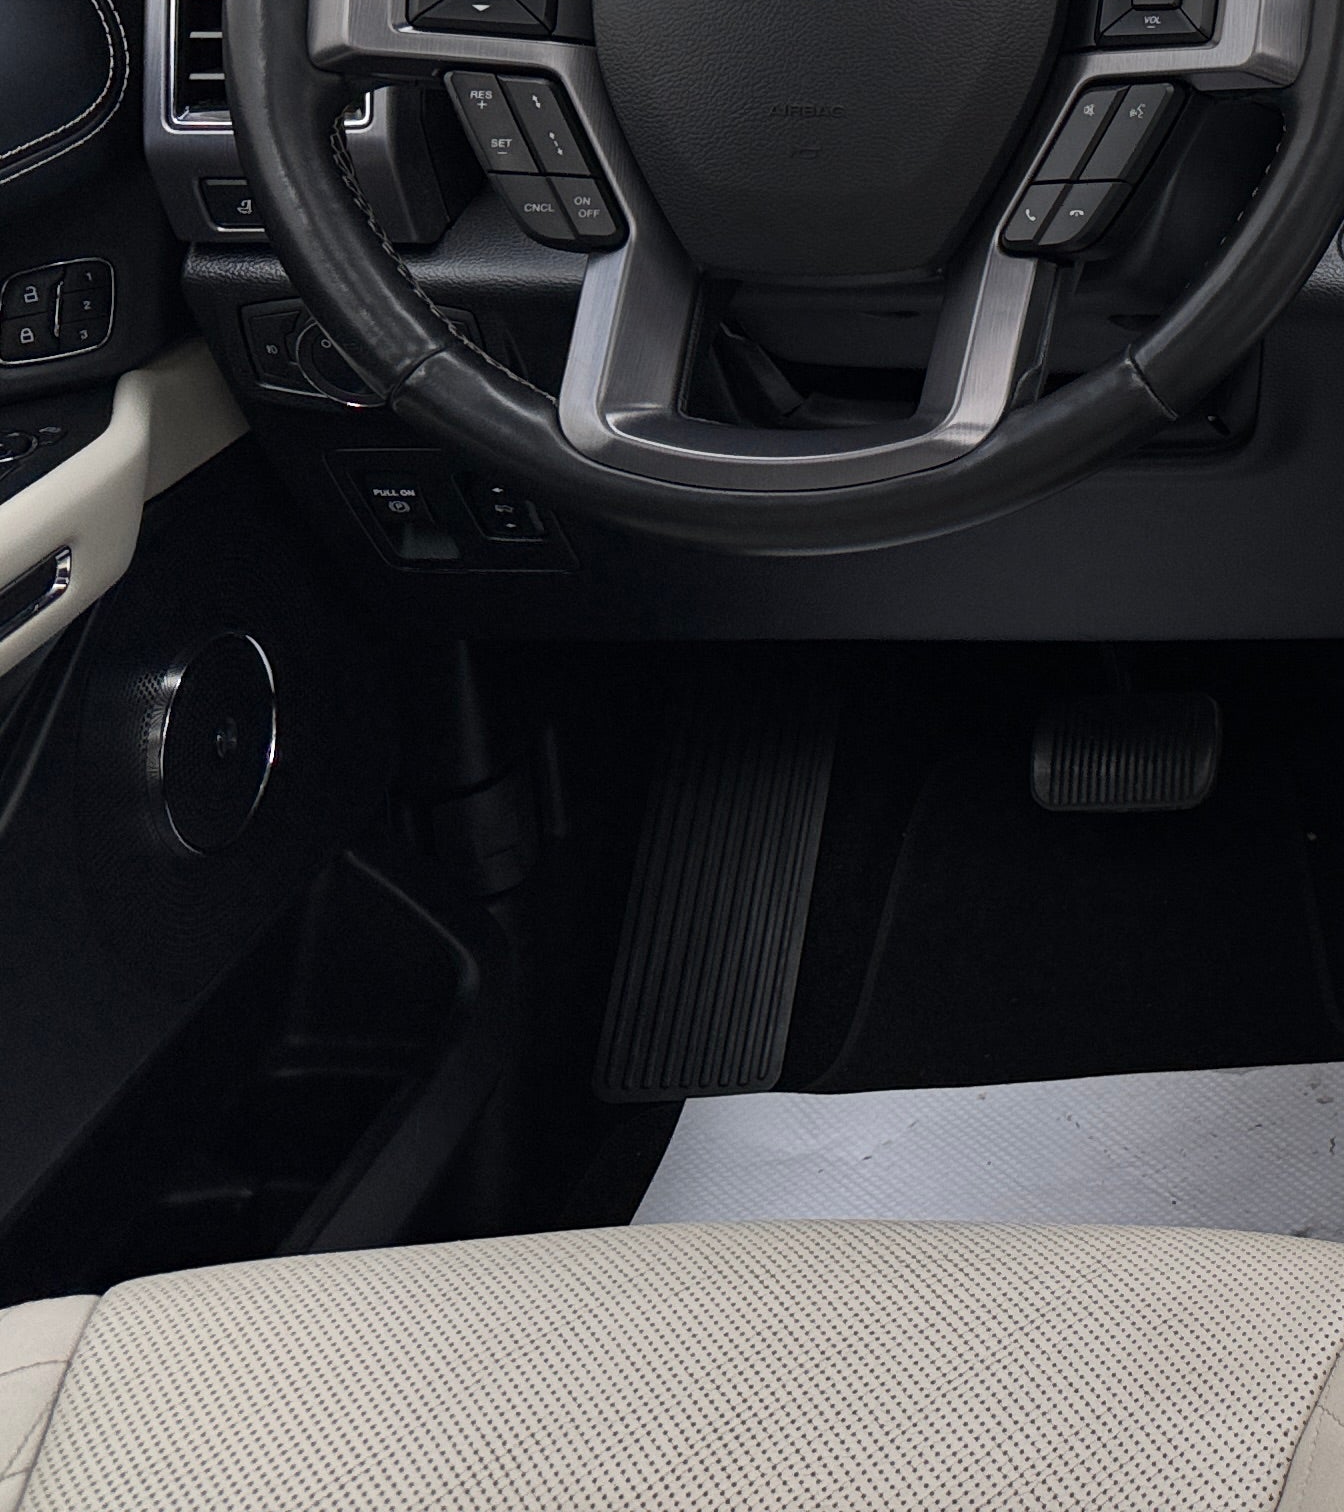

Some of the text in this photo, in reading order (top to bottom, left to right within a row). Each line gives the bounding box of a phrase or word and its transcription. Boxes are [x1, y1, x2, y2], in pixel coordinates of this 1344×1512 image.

[1144, 16, 1161, 25] VOL
[470, 90, 493, 100] RES
[769, 104, 848, 119] AIRBAG
[491, 139, 512, 148] SET
[574, 196, 591, 206] ON
[524, 203, 555, 213] CNCL
[578, 209, 600, 218] OFF
[86, 272, 93, 281] 1
[83, 300, 91, 310] 2
[80, 330, 88, 340] 3
[373, 488, 416, 497] PULL ON
